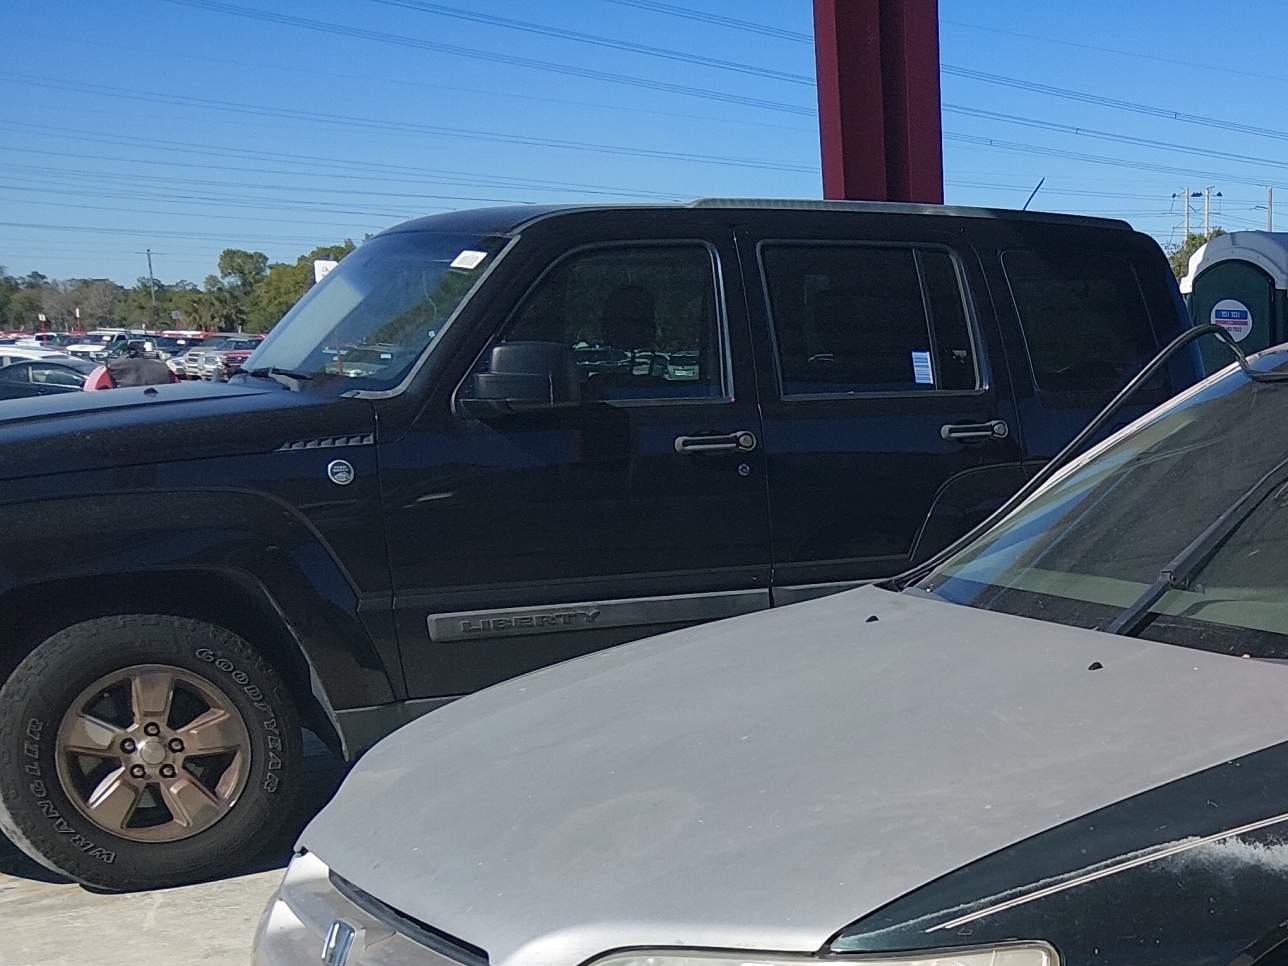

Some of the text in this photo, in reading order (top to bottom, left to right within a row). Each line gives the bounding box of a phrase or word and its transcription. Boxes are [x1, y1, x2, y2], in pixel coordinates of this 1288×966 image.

[461, 610, 600, 633] LIBERTY
[24, 717, 118, 864] WRANGLER
[195, 647, 283, 794] GOODYEAR
